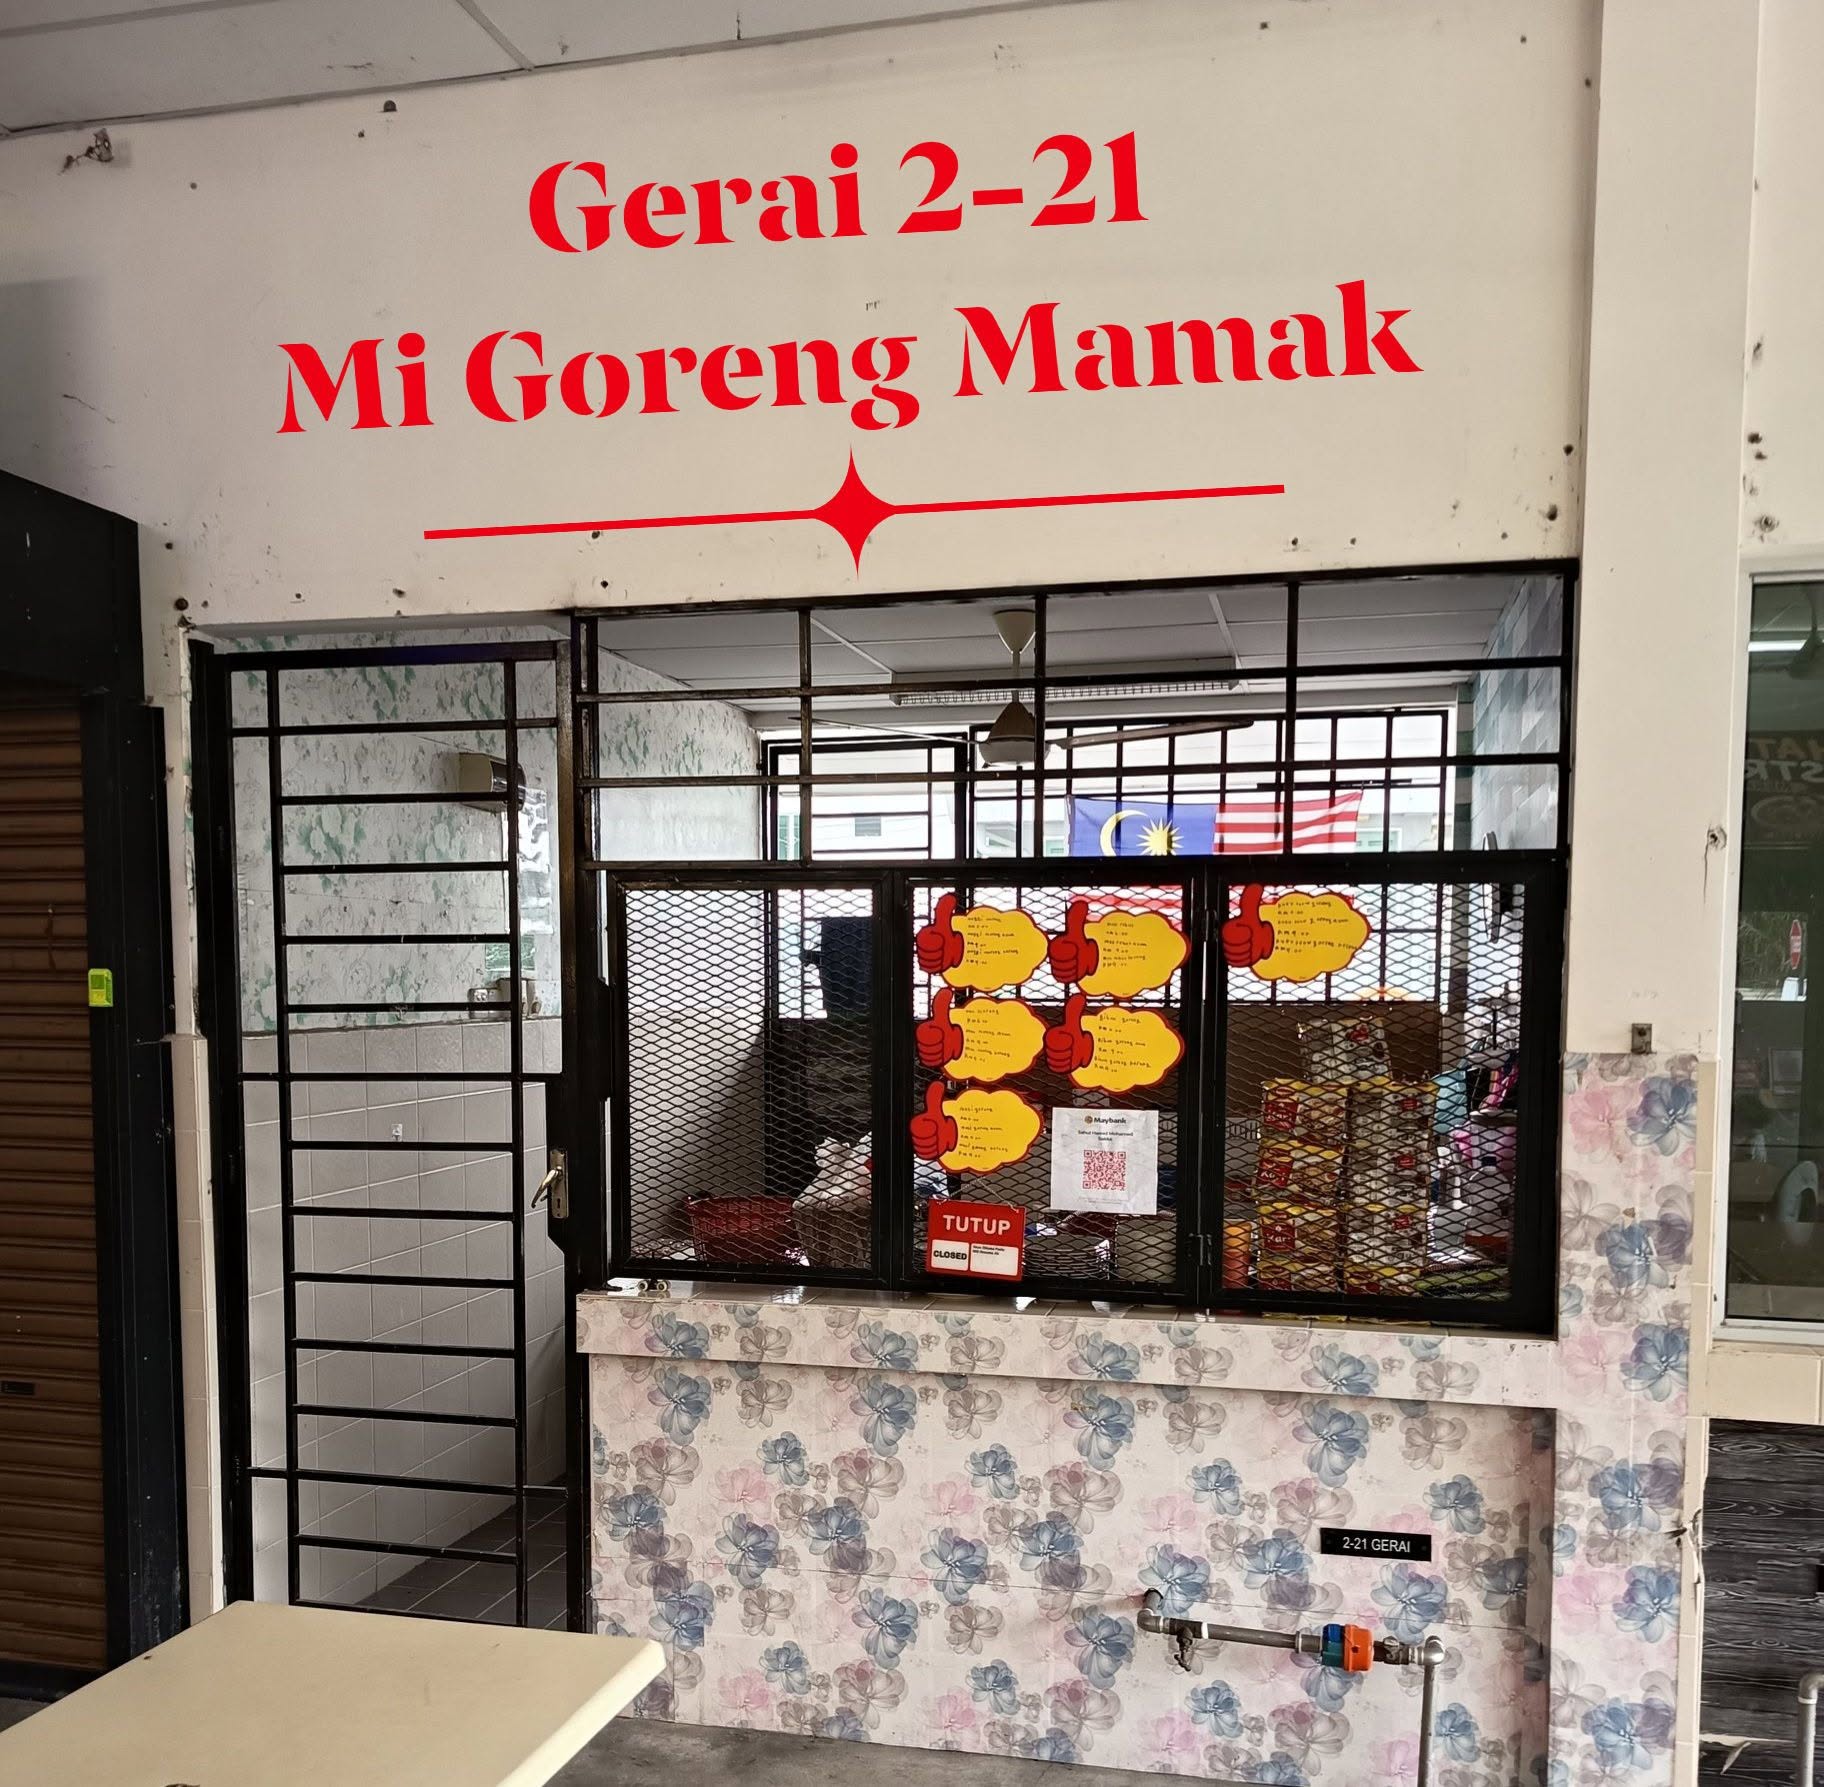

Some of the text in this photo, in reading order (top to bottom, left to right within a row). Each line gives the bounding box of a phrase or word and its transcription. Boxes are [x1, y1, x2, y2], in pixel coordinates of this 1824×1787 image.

[1093, 1116, 1127, 1125] Maybank
[943, 1215, 1011, 1236] TUTUP
[933, 1250, 968, 1261] CLOSED
[1342, 1536, 1411, 1553] 2-21 GERAI
